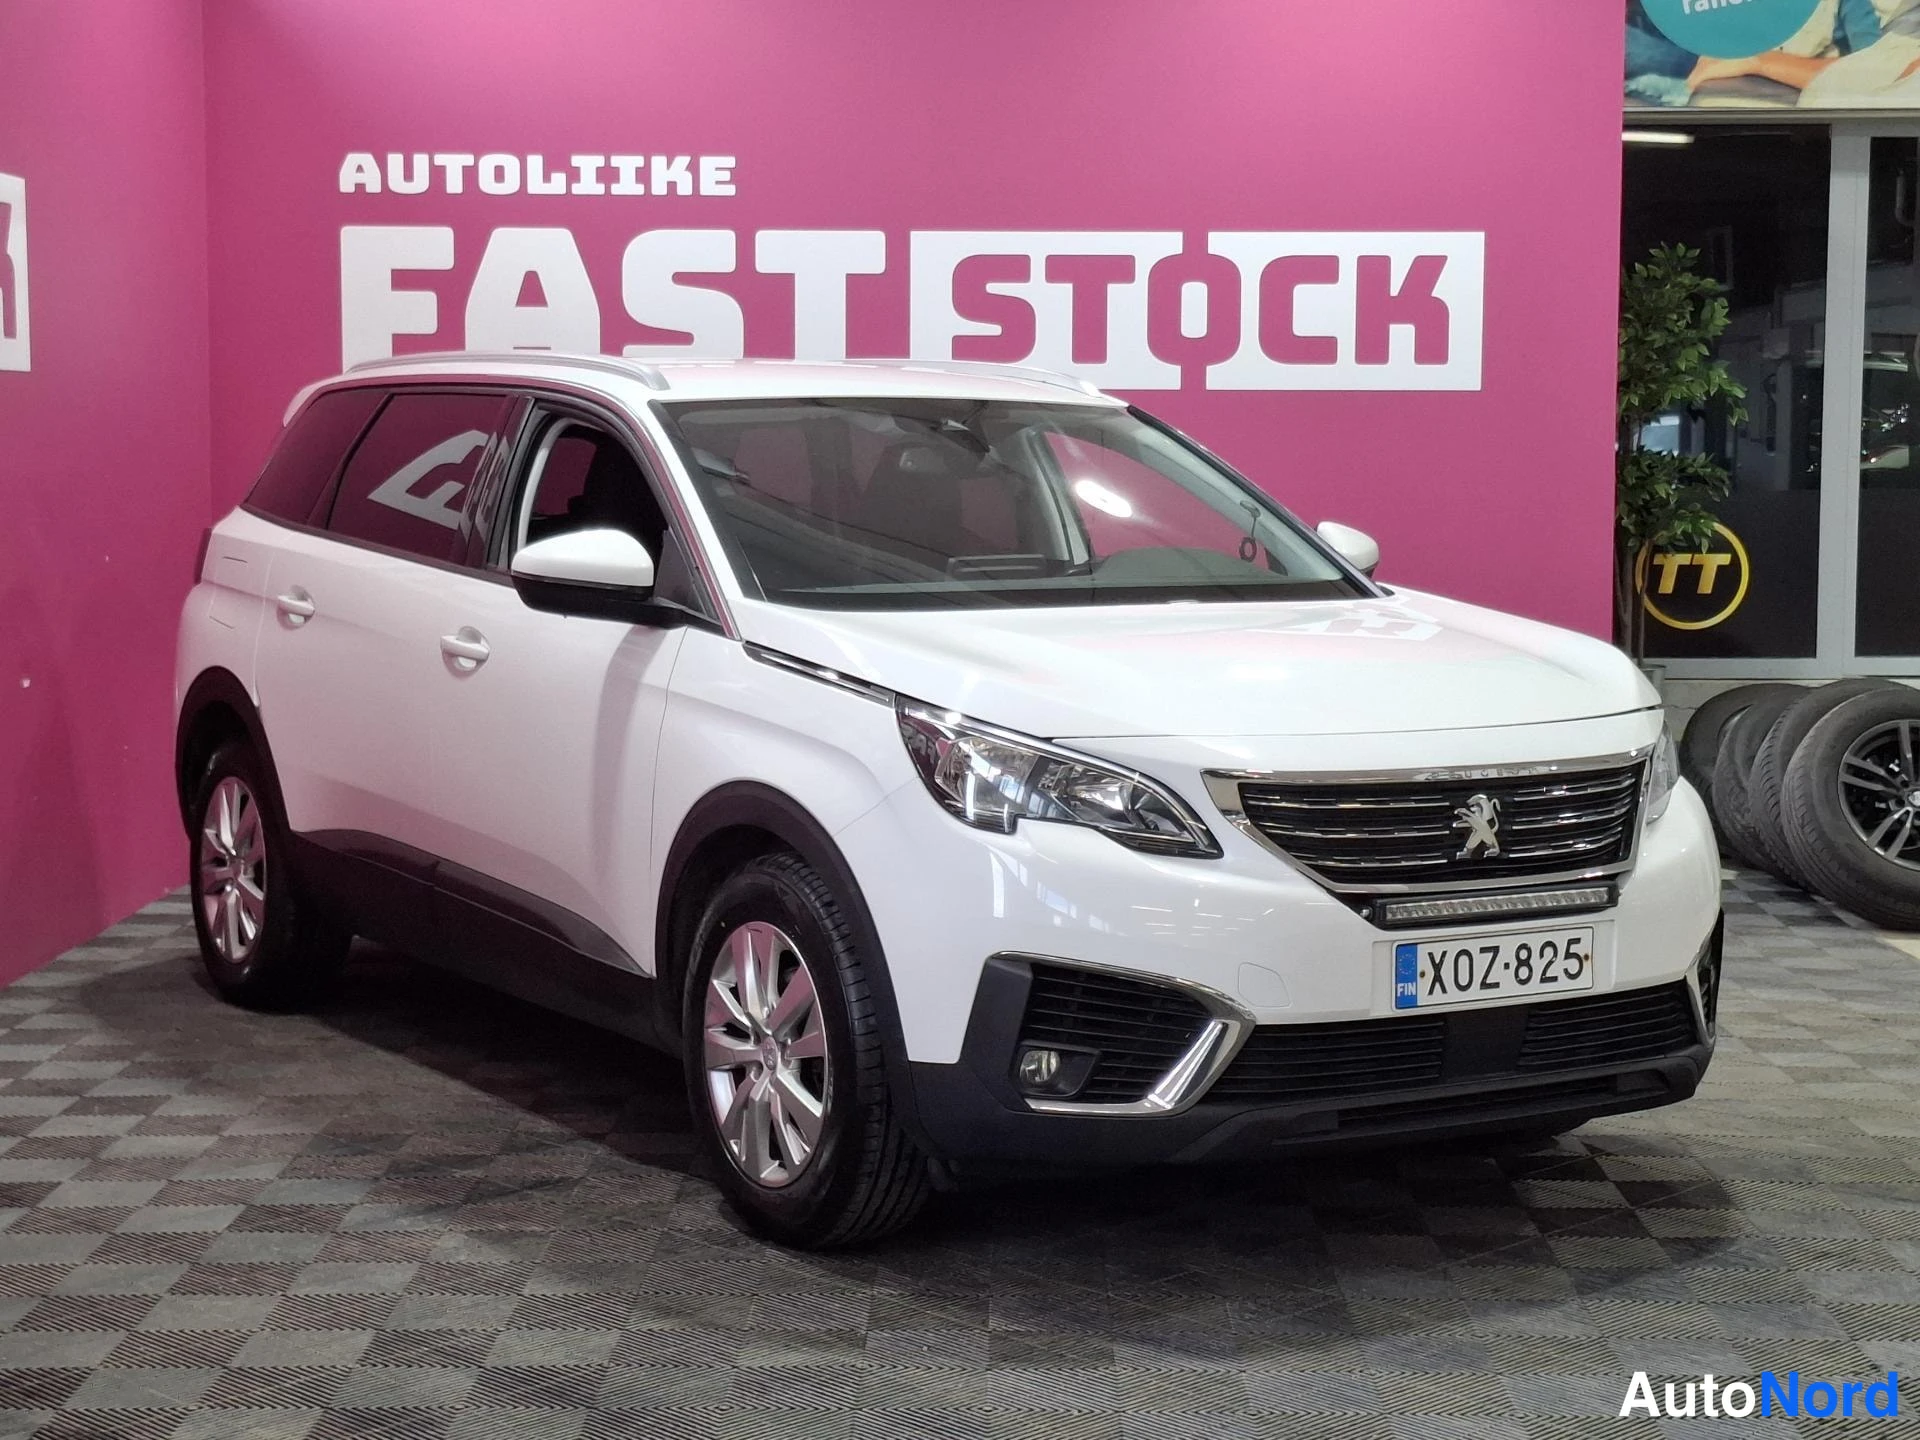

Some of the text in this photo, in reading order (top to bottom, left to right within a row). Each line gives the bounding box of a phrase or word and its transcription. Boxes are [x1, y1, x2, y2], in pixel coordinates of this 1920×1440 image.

[339, 152, 737, 197] AUTOLIIKE
[340, 225, 1451, 375] FAST STOCK
[1653, 552, 1732, 595] TT
[1396, 937, 1584, 997] FIN XOZ-825
